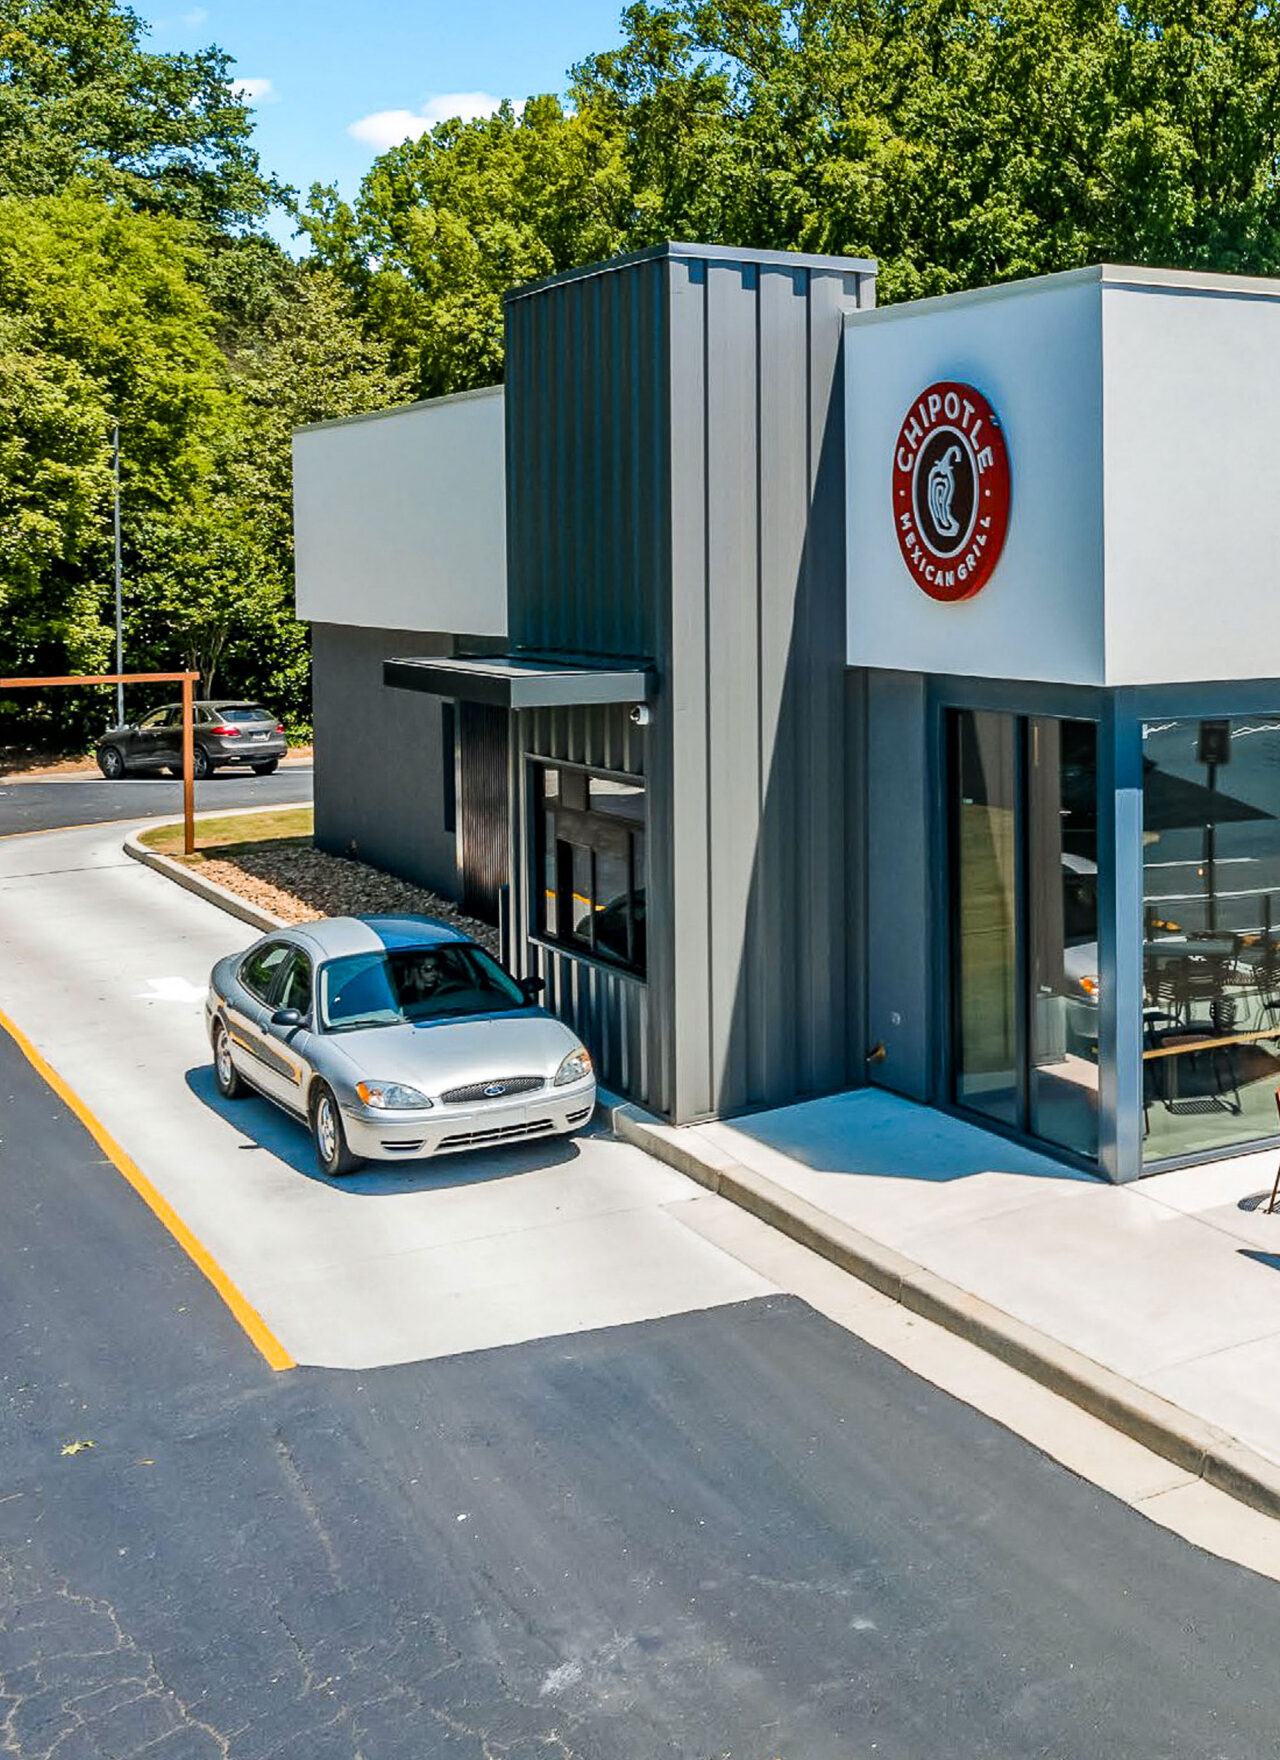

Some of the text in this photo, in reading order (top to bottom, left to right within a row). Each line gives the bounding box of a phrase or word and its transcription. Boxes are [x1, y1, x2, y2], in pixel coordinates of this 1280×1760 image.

[897, 391, 994, 474] CHIPOTLE
[900, 511, 991, 587] MEXICAN GRILL
